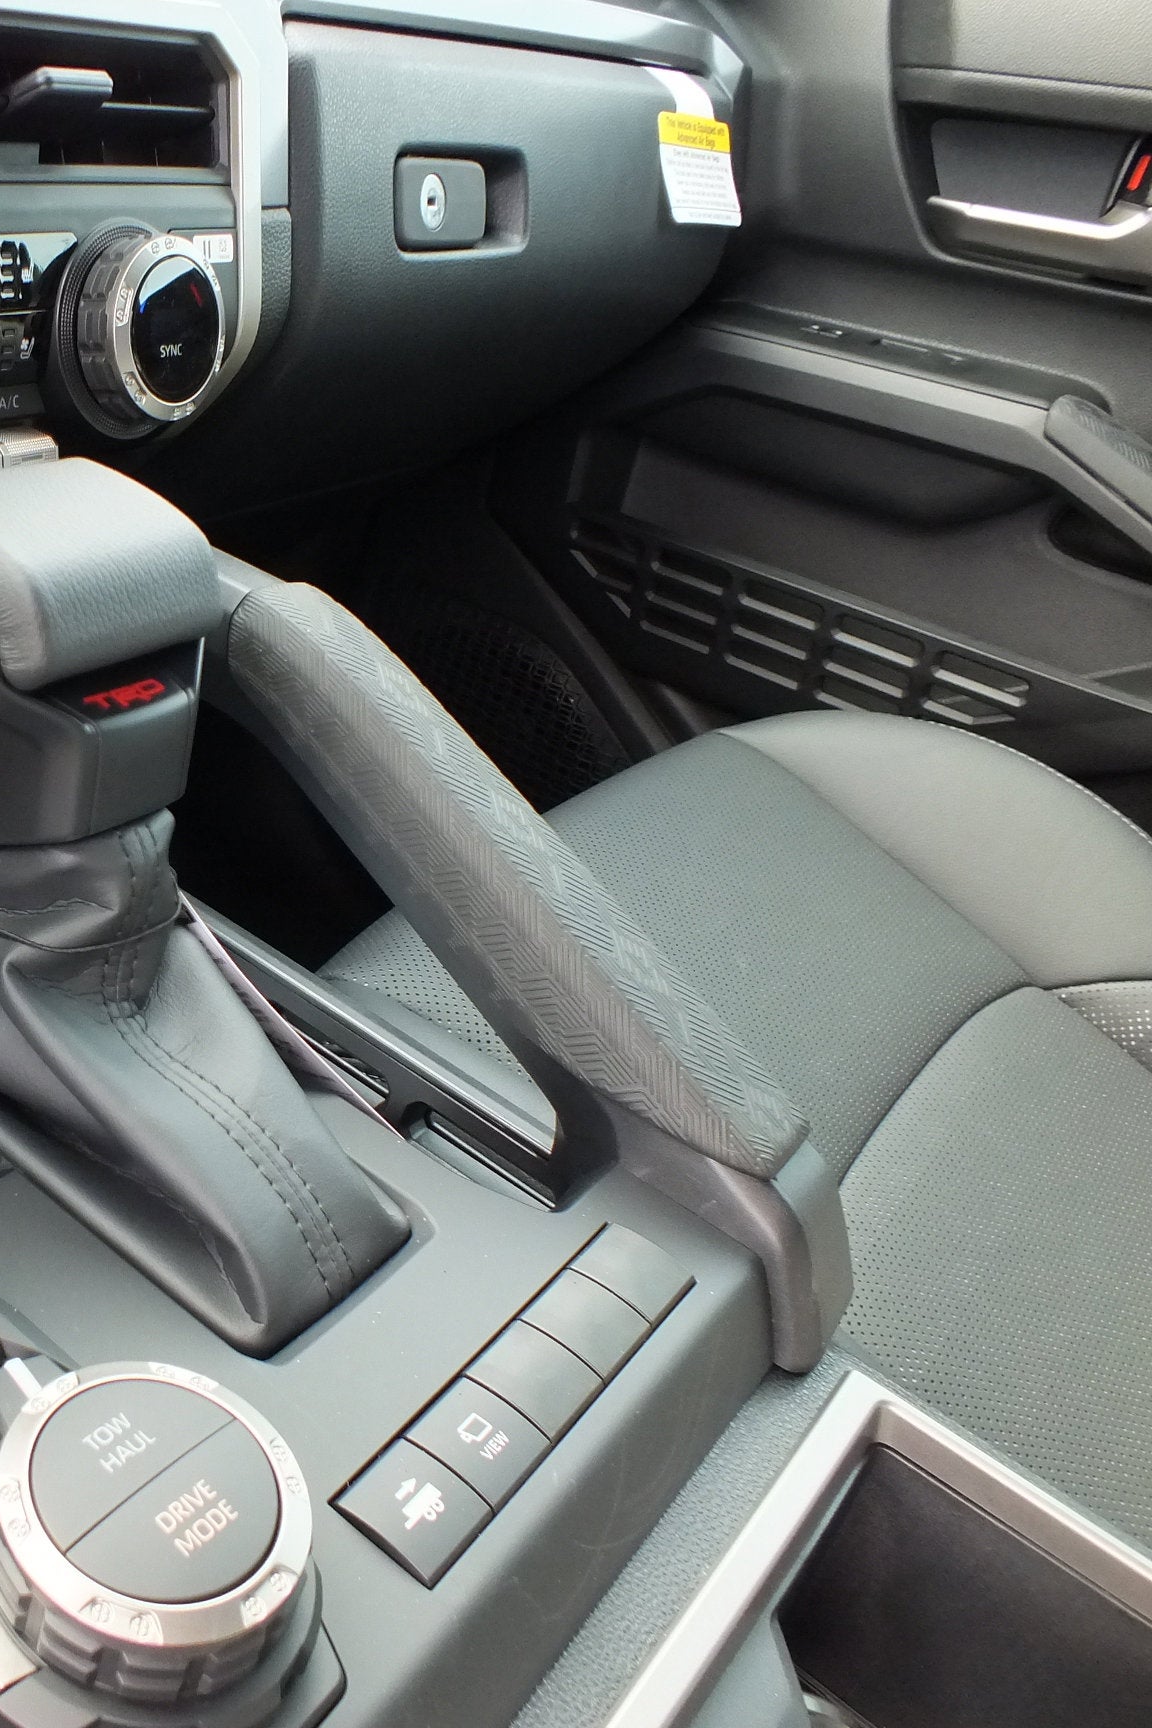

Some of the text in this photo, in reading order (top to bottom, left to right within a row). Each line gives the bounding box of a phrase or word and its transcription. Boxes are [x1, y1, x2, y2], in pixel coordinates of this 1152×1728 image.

[160, 344, 183, 358] SYNC
[82, 679, 165, 710] TRD
[81, 1412, 132, 1451] TOW
[480, 1430, 510, 1460] VIEW
[99, 1430, 156, 1474] HAUL
[155, 1479, 218, 1535] DRIVE
[174, 1499, 239, 1558] MODE
